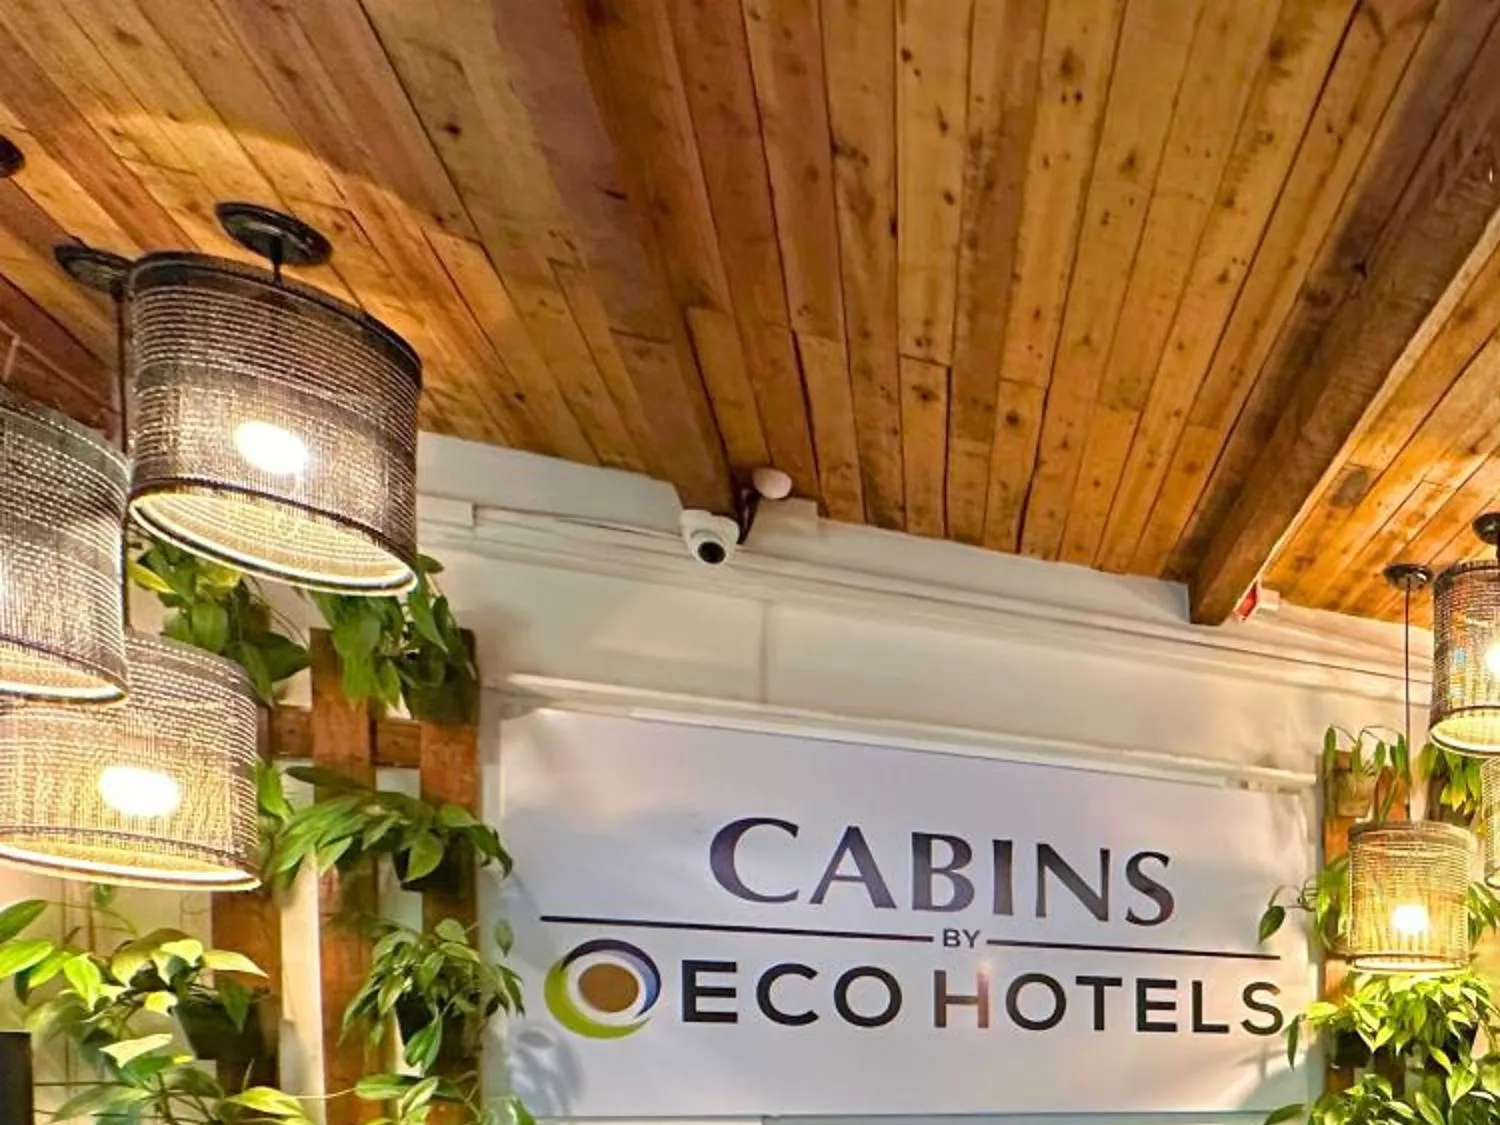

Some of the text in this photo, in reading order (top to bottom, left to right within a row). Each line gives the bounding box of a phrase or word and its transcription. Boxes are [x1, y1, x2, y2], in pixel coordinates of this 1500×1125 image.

[709, 817, 1175, 927] CABINS
[942, 927, 981, 949] BY
[682, 959, 1284, 1037] ECO HOTELS
